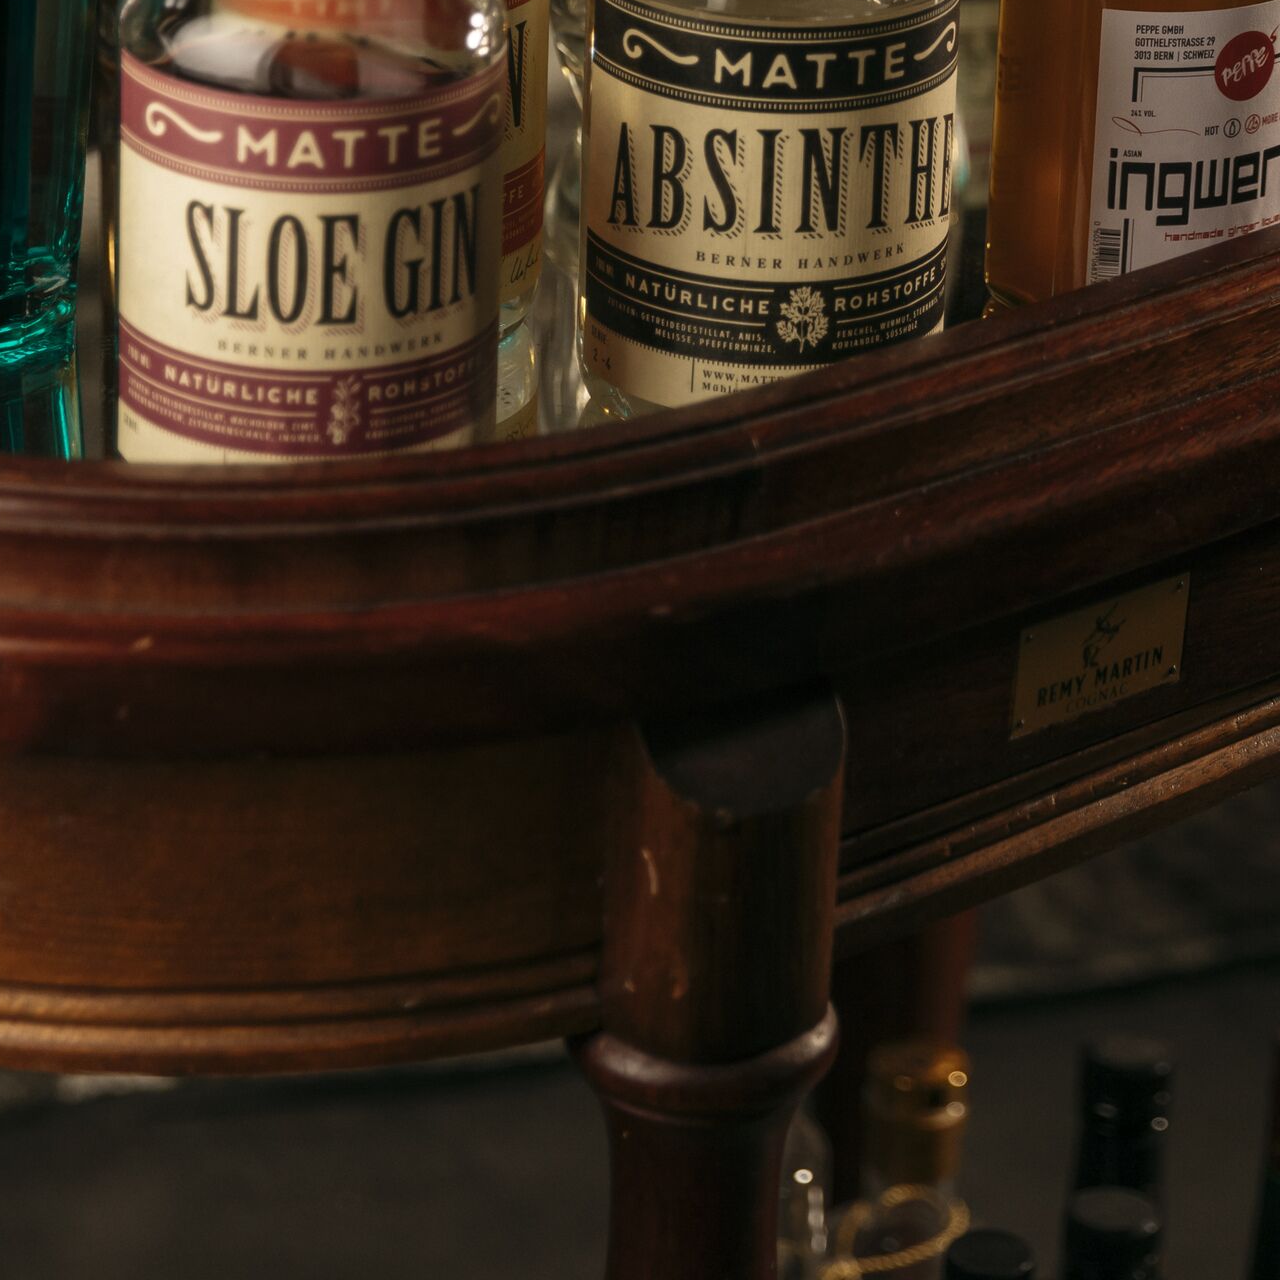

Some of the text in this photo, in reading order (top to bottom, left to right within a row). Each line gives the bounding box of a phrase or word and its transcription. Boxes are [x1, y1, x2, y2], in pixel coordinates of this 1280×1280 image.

[1135, 24, 1184, 36] PEPPE GMBH
[1135, 35, 1216, 48] GOTTHELFSTRASSE 29
[714, 41, 908, 90] MATTE
[1133, 49, 1152, 61] 3013
[1153, 50, 1174, 61] BERN
[1182, 48, 1215, 61] SCHWEIZ
[235, 120, 444, 169] MATTE
[1204, 125, 1220, 137] HOT
[1122, 148, 1143, 158] ASIAN
[607, 113, 954, 236] ABSINTHE
[1164, 226, 1224, 242] handmade
[185, 184, 482, 329] SLOE GIN
[696, 243, 906, 270] BERNER HANDWERK
[625, 266, 936, 315] NATÜRLICHE ROHSTOFFE
[217, 332, 444, 361] BERNER HANDWERK
[164, 363, 319, 406] NATÜRLICHE
[1036, 646, 1164, 708] REMY MARTIN
